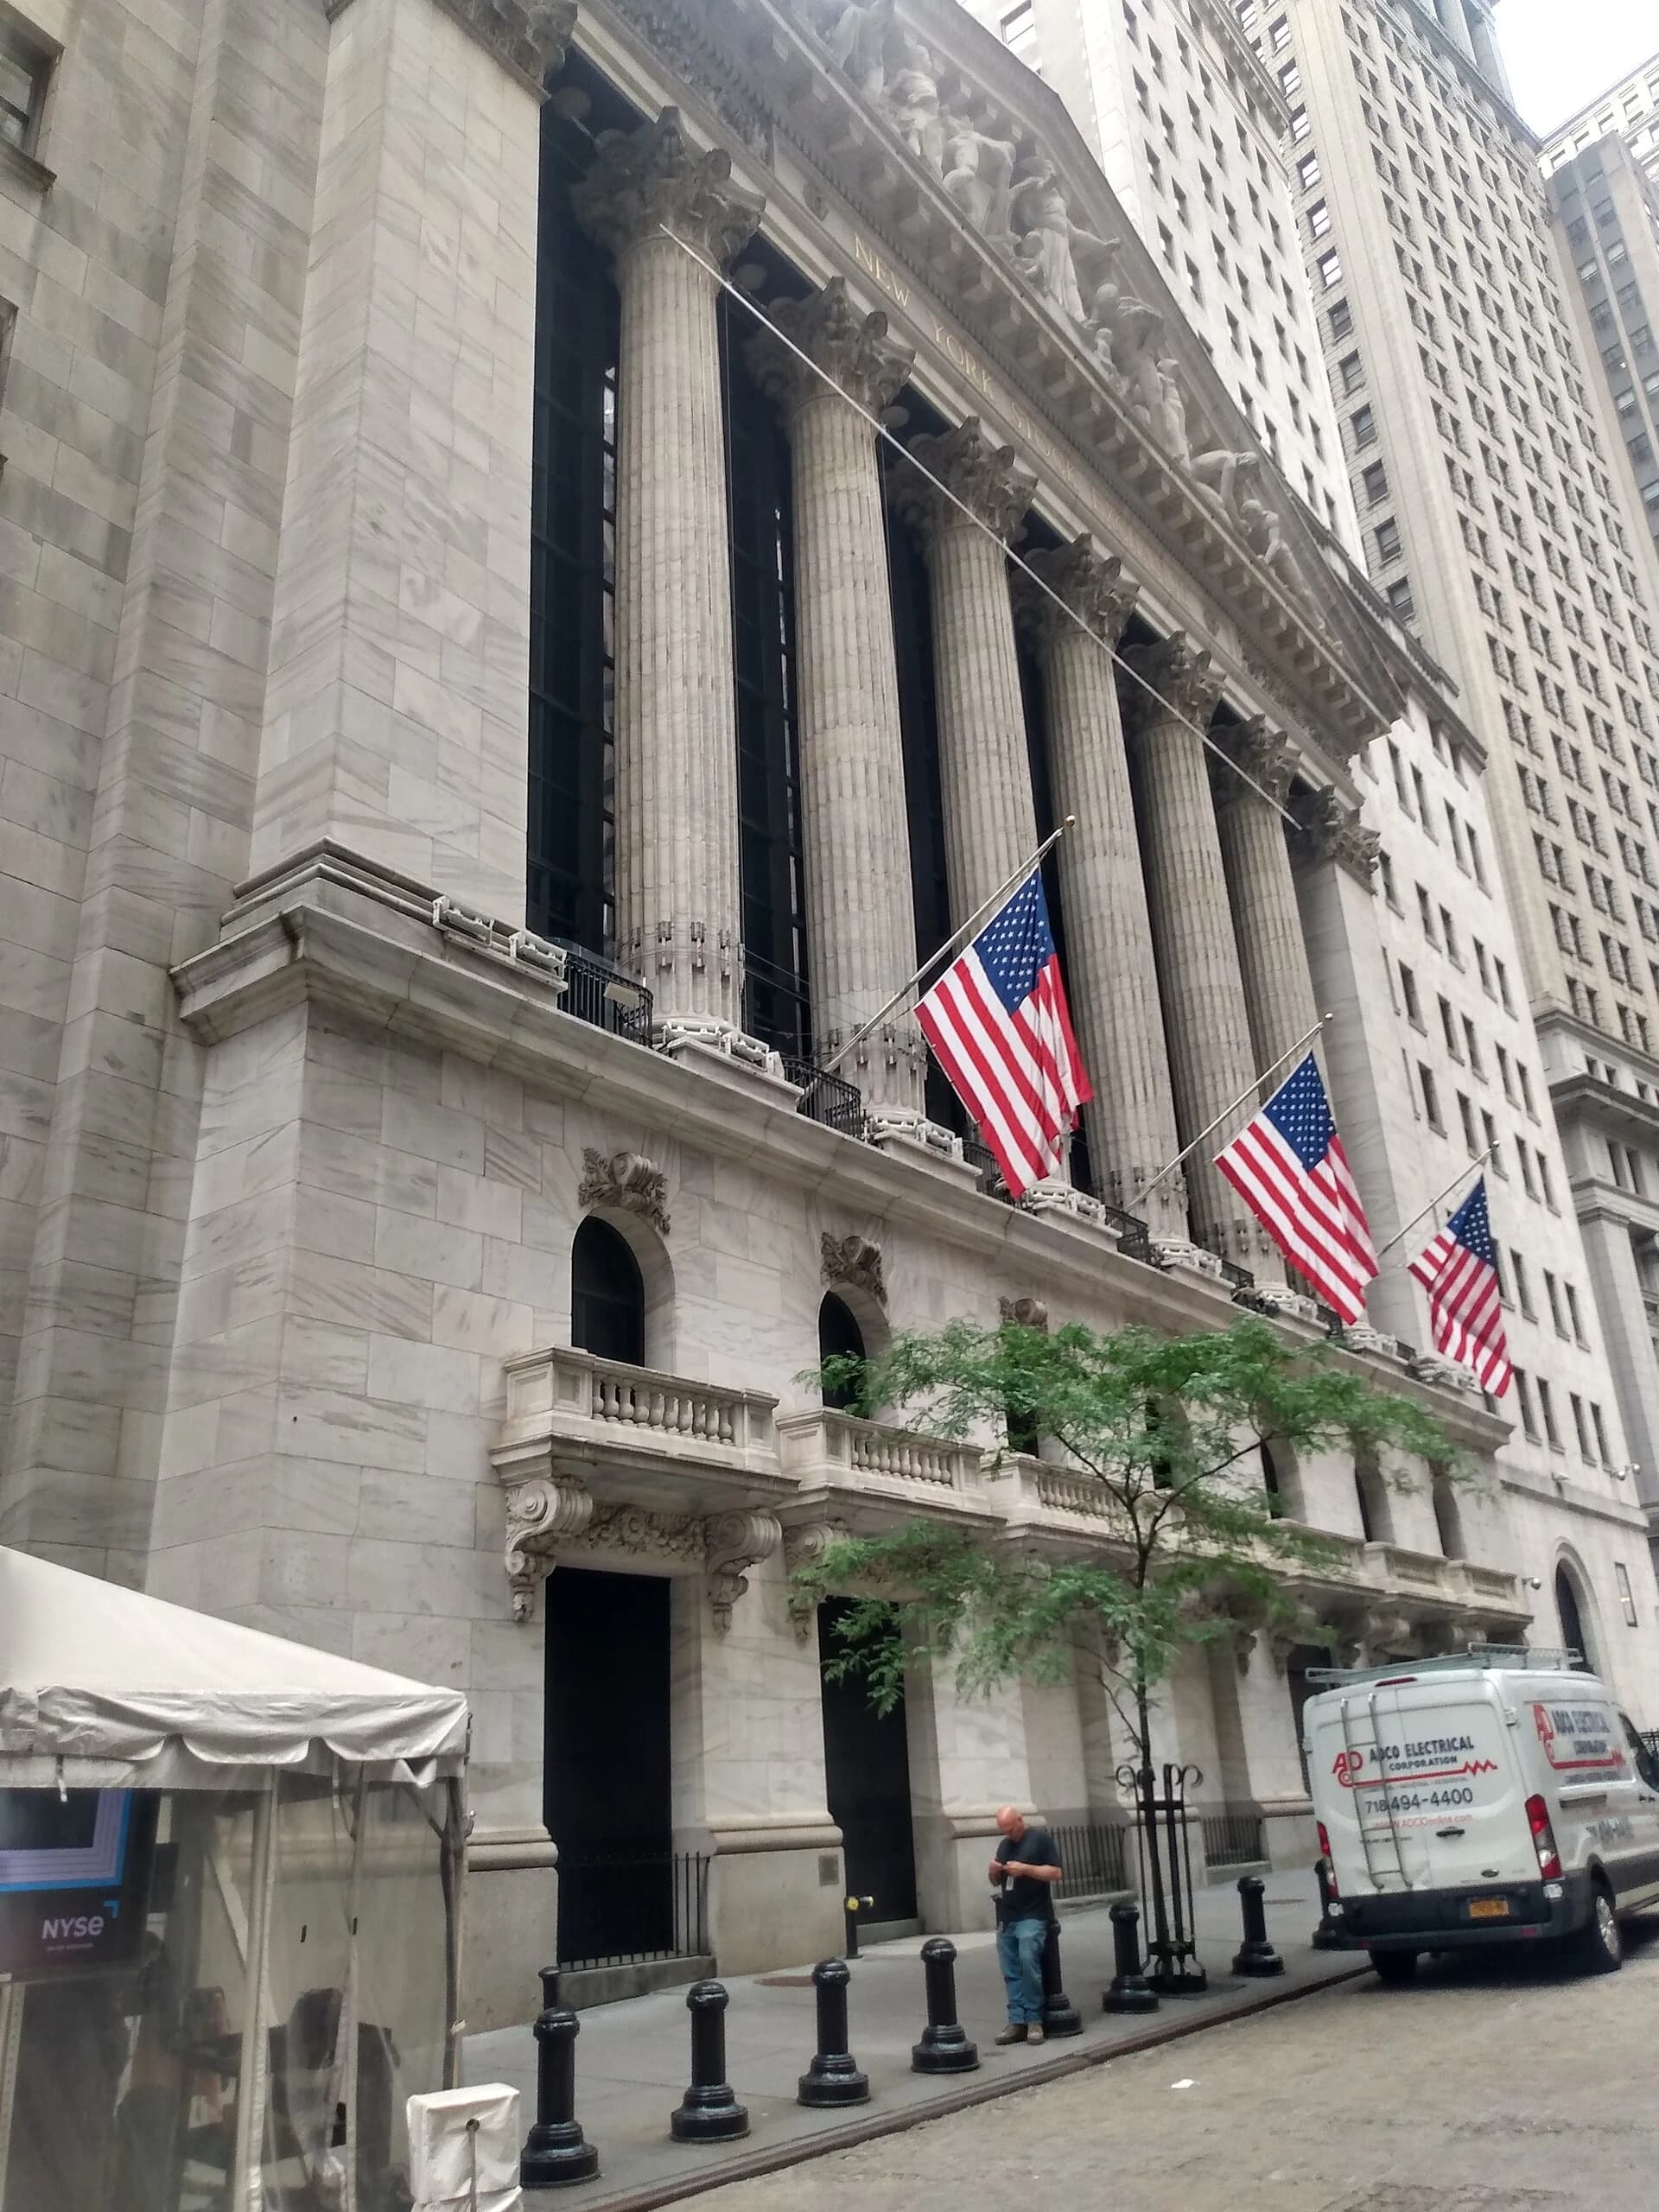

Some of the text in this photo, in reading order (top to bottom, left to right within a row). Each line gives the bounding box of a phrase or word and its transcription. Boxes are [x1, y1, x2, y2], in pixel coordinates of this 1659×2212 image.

[852, 233, 910, 308] NEW
[929, 310, 995, 400] YORK
[1404, 1735, 1475, 1758] ELECTRICAL
[1389, 1755, 1458, 1771] CORPORATION
[1364, 1787, 1474, 1815] 718494-4400
